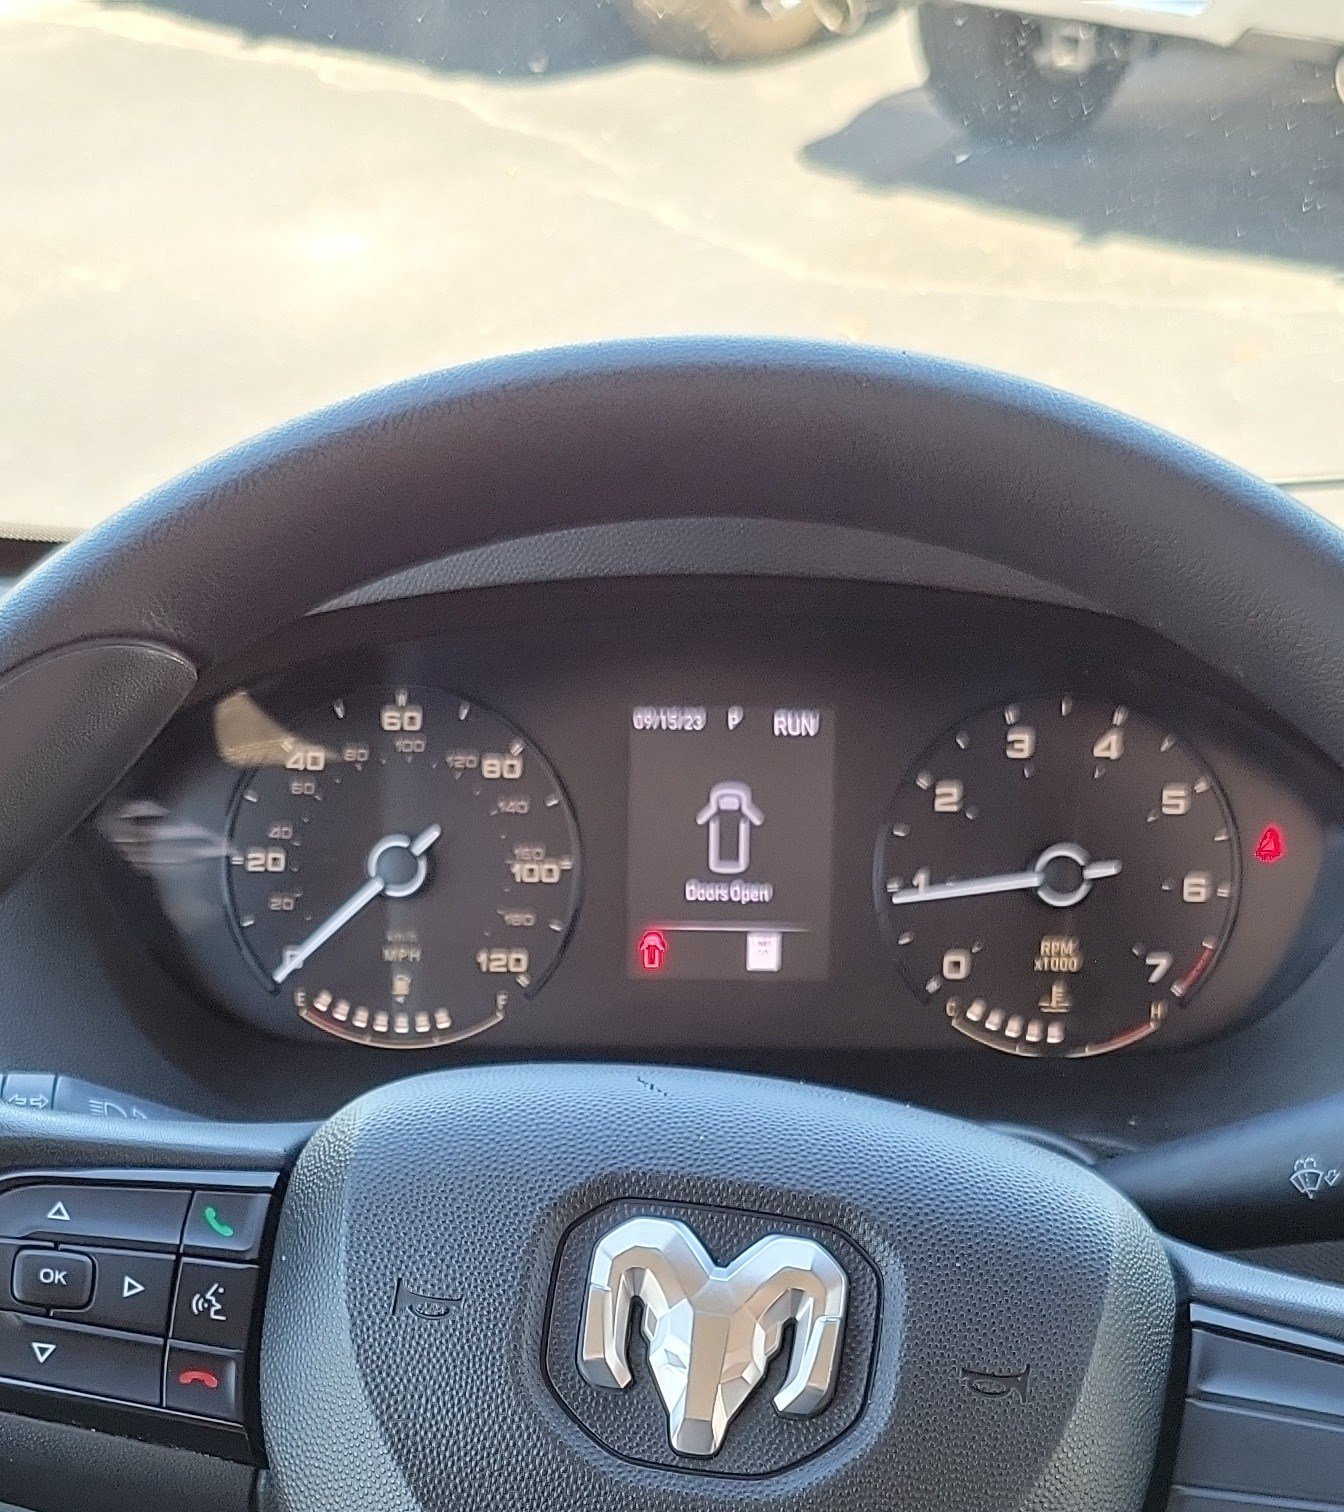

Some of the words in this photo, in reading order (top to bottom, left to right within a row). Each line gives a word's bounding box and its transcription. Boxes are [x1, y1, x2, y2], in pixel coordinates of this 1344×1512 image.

[381, 706, 423, 731] 60
[633, 706, 706, 731] 09/15/23
[727, 705, 743, 731] P
[774, 709, 819, 737] RUN
[1006, 725, 1036, 759] 3
[1093, 728, 1125, 759] 4
[285, 750, 326, 771] 40
[481, 755, 523, 779] 80
[933, 779, 963, 813] 2
[1161, 783, 1193, 816] 5
[246, 850, 287, 872] 20
[511, 862, 561, 883] 100
[685, 879, 729, 902] Doors
[729, 879, 773, 905] Open
[1182, 870, 1212, 902] 6
[1040, 936, 1078, 956] RPM
[476, 949, 529, 973] 120
[942, 949, 972, 980] 0
[1034, 955, 1083, 973] x1000
[1145, 950, 1173, 983] 7
[39, 1267, 68, 1286] OK
